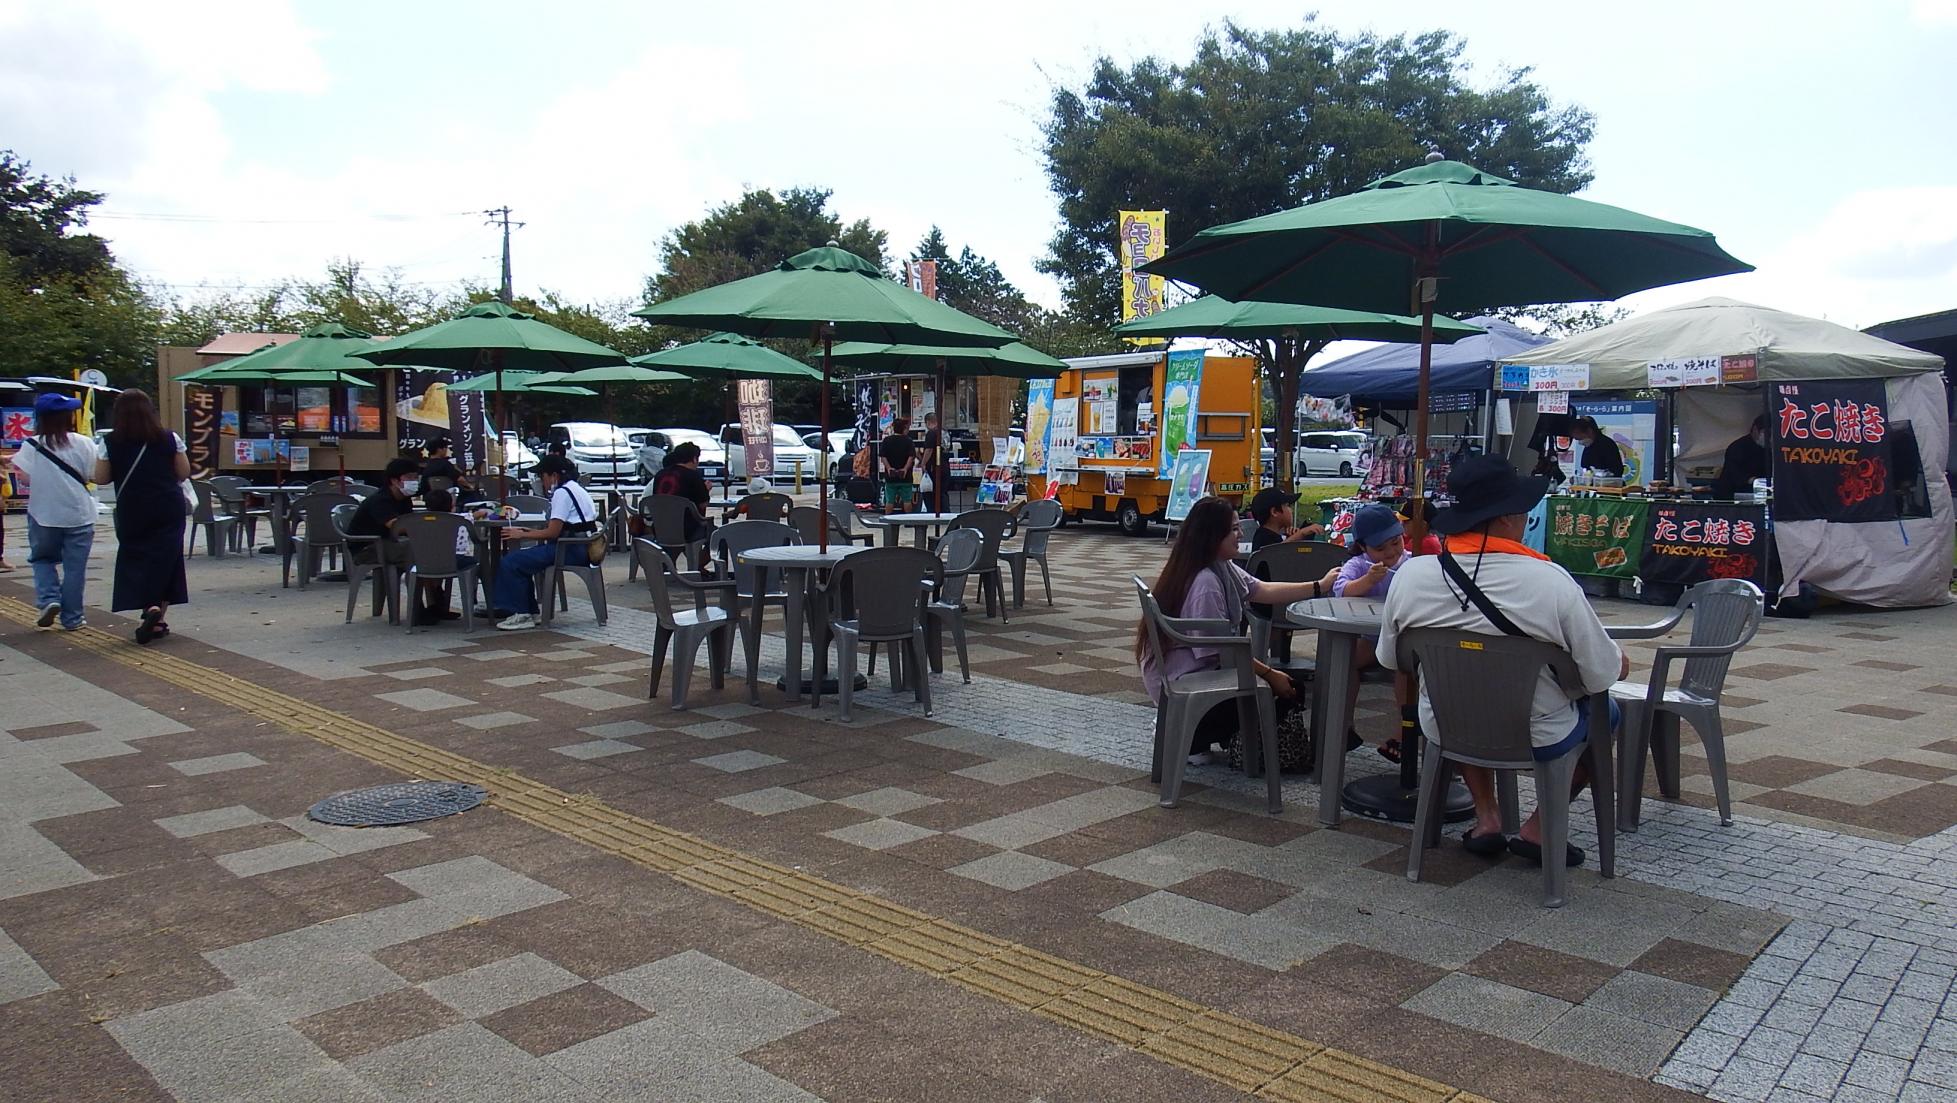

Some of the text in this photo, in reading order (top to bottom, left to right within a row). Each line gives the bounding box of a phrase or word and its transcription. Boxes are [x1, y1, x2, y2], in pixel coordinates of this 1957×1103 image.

[1130, 223, 1152, 322] チョコバナ
[5, 412, 33, 440] 氷
[1779, 398, 1885, 443] たこ焼き
[1781, 446, 1858, 465] TAKOYAKI
[1554, 511, 1634, 539] 焼きそば
[1654, 517, 1756, 546] たこ焼き
[1652, 543, 1728, 558] TAKOYAKI
